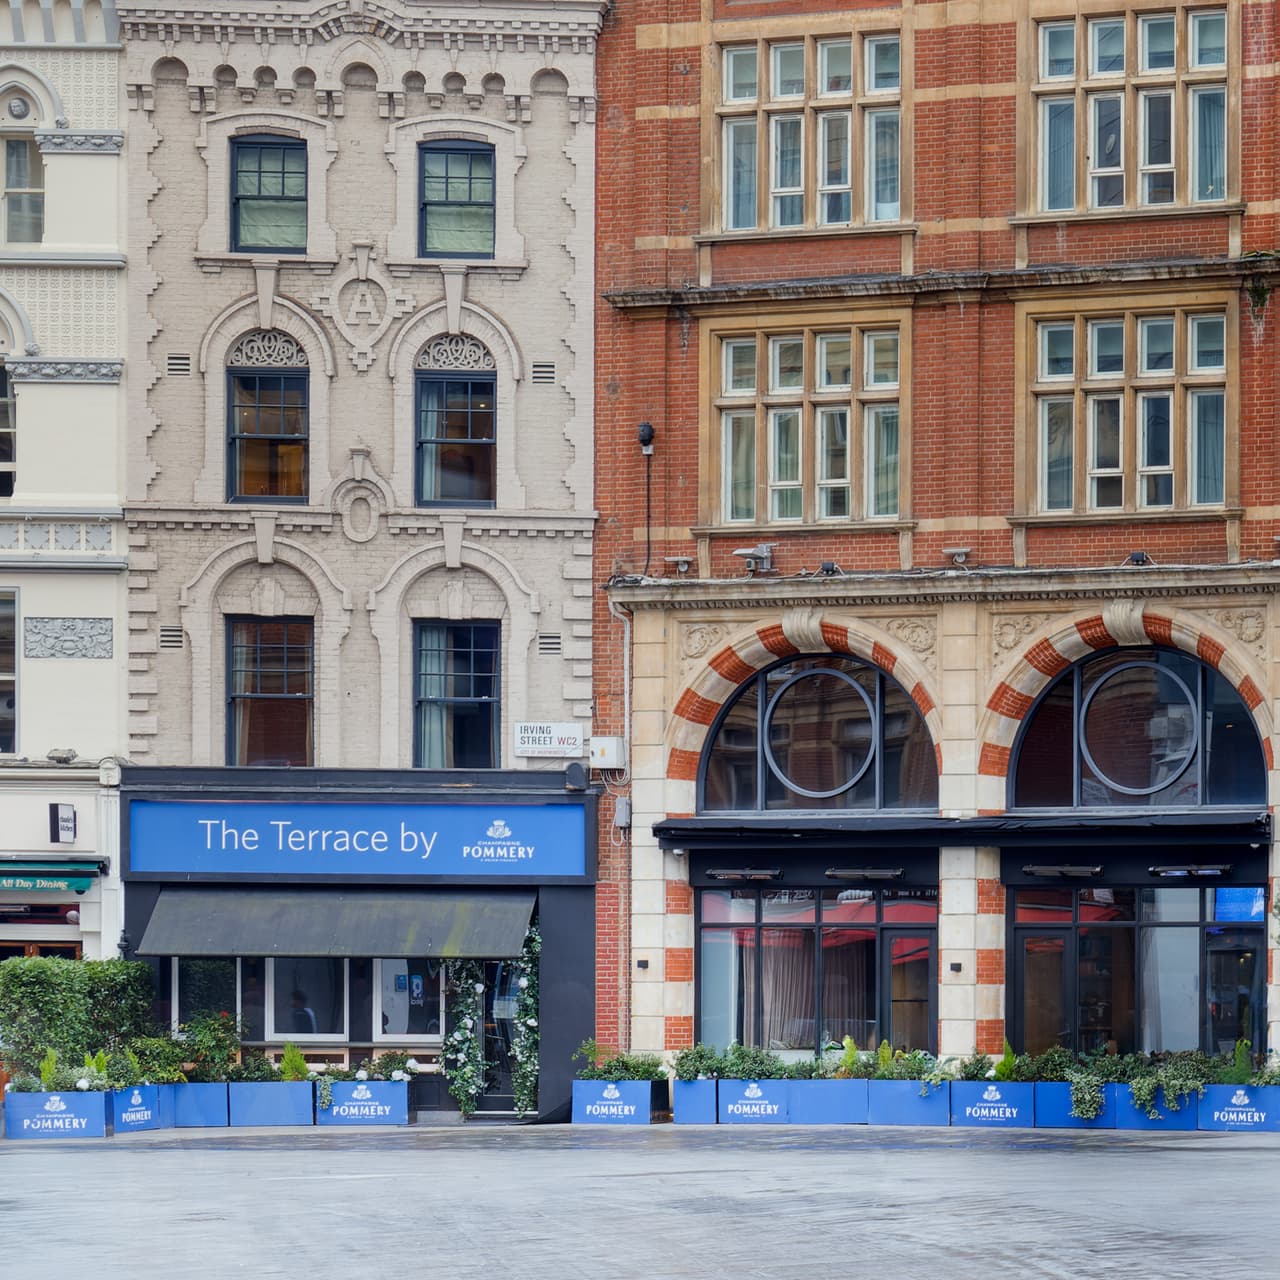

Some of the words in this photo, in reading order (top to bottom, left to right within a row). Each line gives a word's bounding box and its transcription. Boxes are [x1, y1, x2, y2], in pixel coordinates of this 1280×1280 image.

[520, 725, 552, 735] IRVING
[520, 735, 553, 745] STREET
[557, 736, 577, 745] WC2
[198, 820, 259, 850] The
[270, 821, 388, 852] Terrace
[401, 822, 438, 859] by
[462, 846, 535, 859] POMMERY
[15, 880, 33, 889] Day
[332, 1106, 391, 1116] POMMERY
[586, 1105, 636, 1116] POMMERY
[727, 1104, 779, 1115] POMMERY
[966, 1107, 1018, 1118] POMMERY
[122, 1110, 152, 1122] POMMERY
[1213, 1111, 1266, 1122] POMMERY
